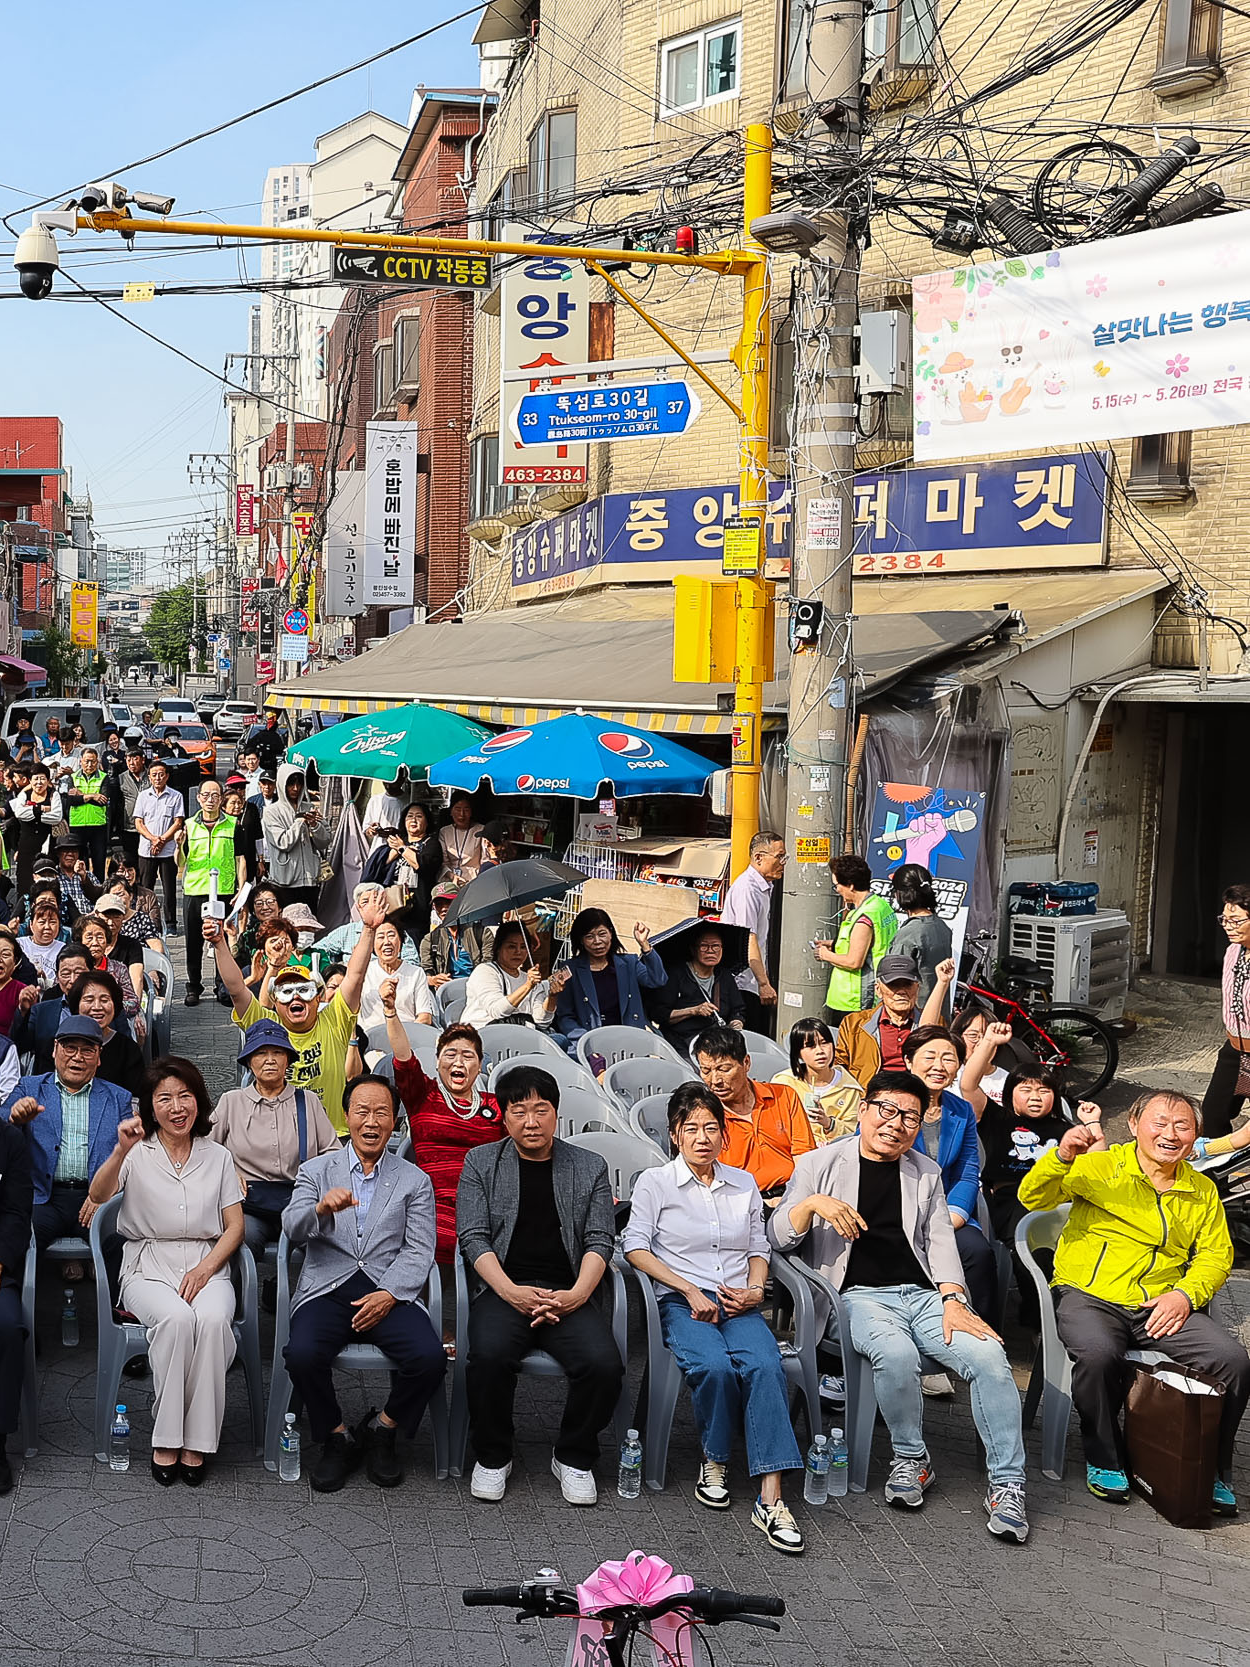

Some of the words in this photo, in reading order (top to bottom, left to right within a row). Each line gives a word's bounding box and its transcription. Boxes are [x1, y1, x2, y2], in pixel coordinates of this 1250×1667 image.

[383, 256, 433, 280] CCTV
[436, 258, 488, 285] 작동중
[1092, 311, 1193, 347] 살맛나는
[556, 388, 648, 412] 뚝섬로30길
[1092, 393, 1137, 410] 5.15(수)
[1156, 383, 1208, 402] 5.26(일)
[1213, 376, 1244, 394] 전국
[549, 412, 620, 426] Ttukseom-ro
[624, 407, 657, 421] 30-gil
[667, 400, 684, 414] 37
[522, 413, 538, 426] 33
[506, 468, 582, 482] 463-2384
[384, 459, 403, 514] 혼밥에
[383, 518, 401, 554] 빠진
[515, 507, 598, 578] 중앙슈퍼마켓
[383, 560, 401, 578] 날
[75, 594, 93, 642] 부동산
[626, 759, 670, 771] pepsi
[535, 777, 570, 791] pepsi
[931, 880, 965, 892] 2024
